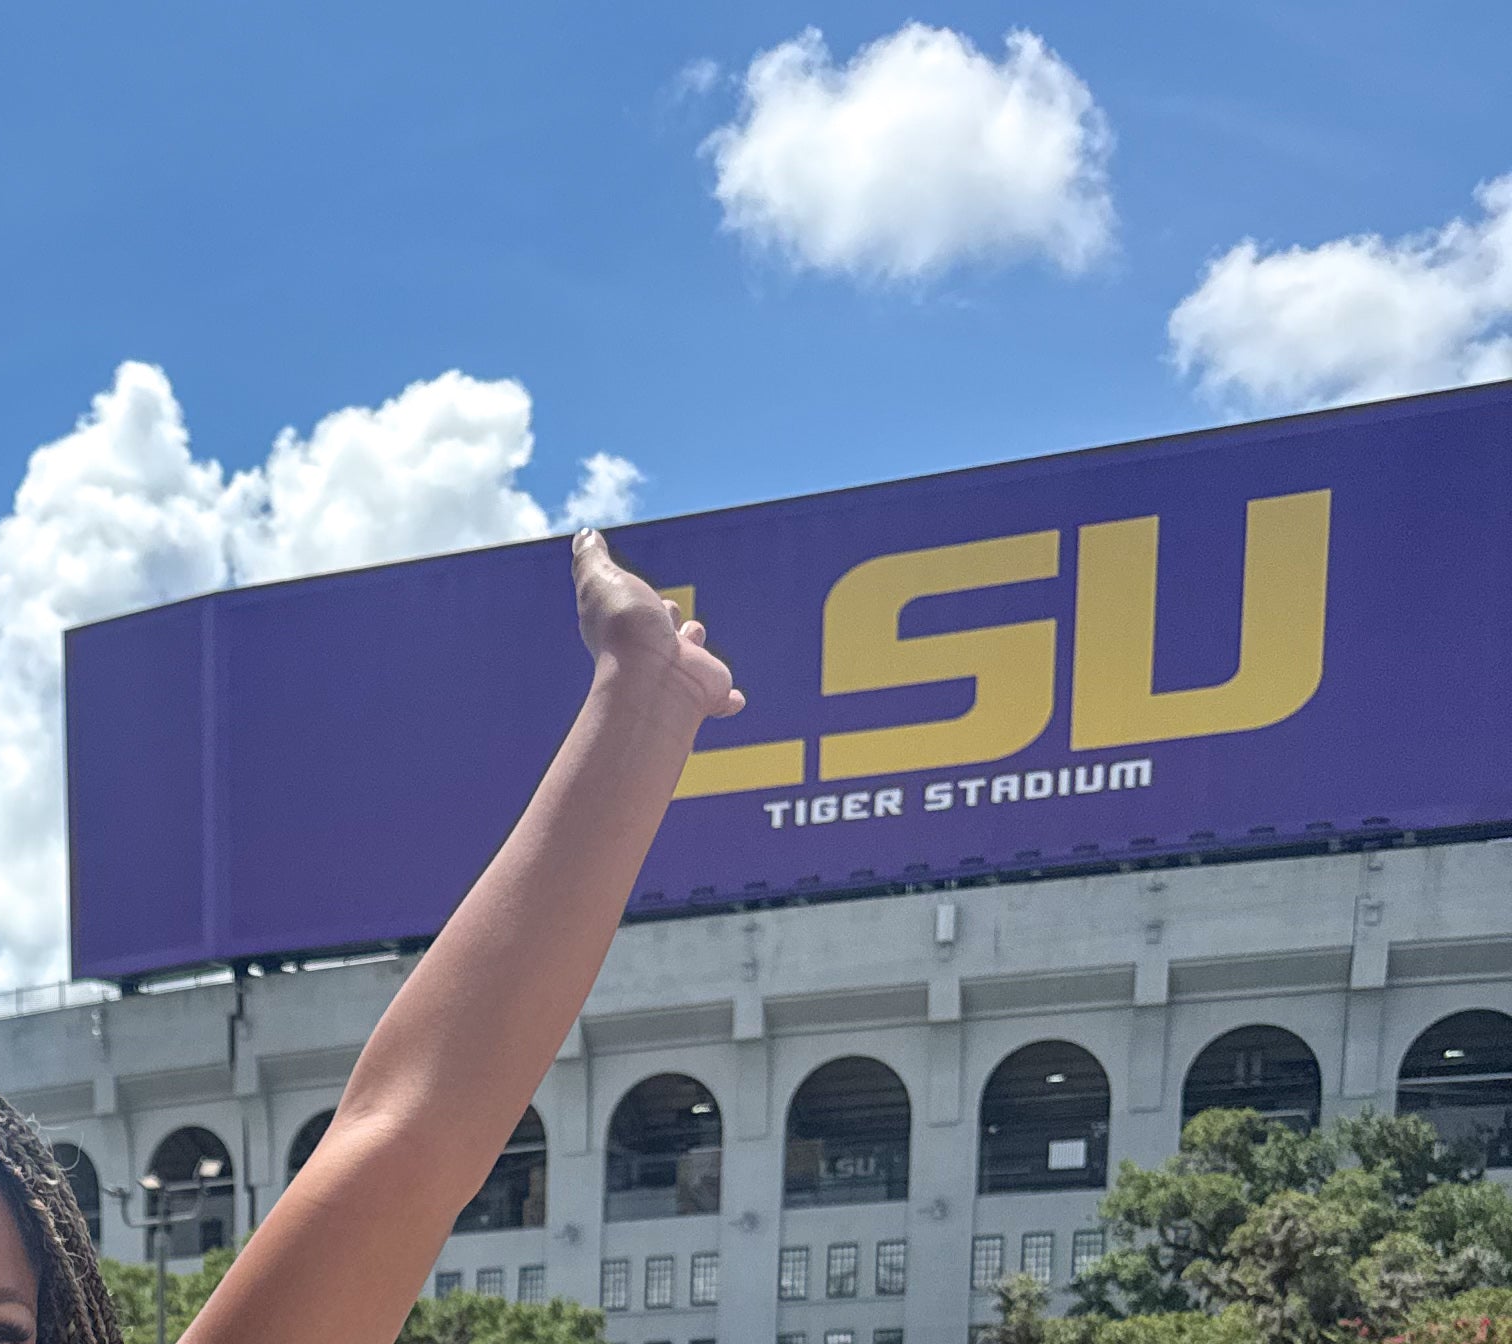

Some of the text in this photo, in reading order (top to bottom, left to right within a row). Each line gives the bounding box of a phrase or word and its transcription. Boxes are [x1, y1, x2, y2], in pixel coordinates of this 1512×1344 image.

[763, 757, 1153, 830] TIGER STADIUM
[818, 1157, 877, 1179] LSU
